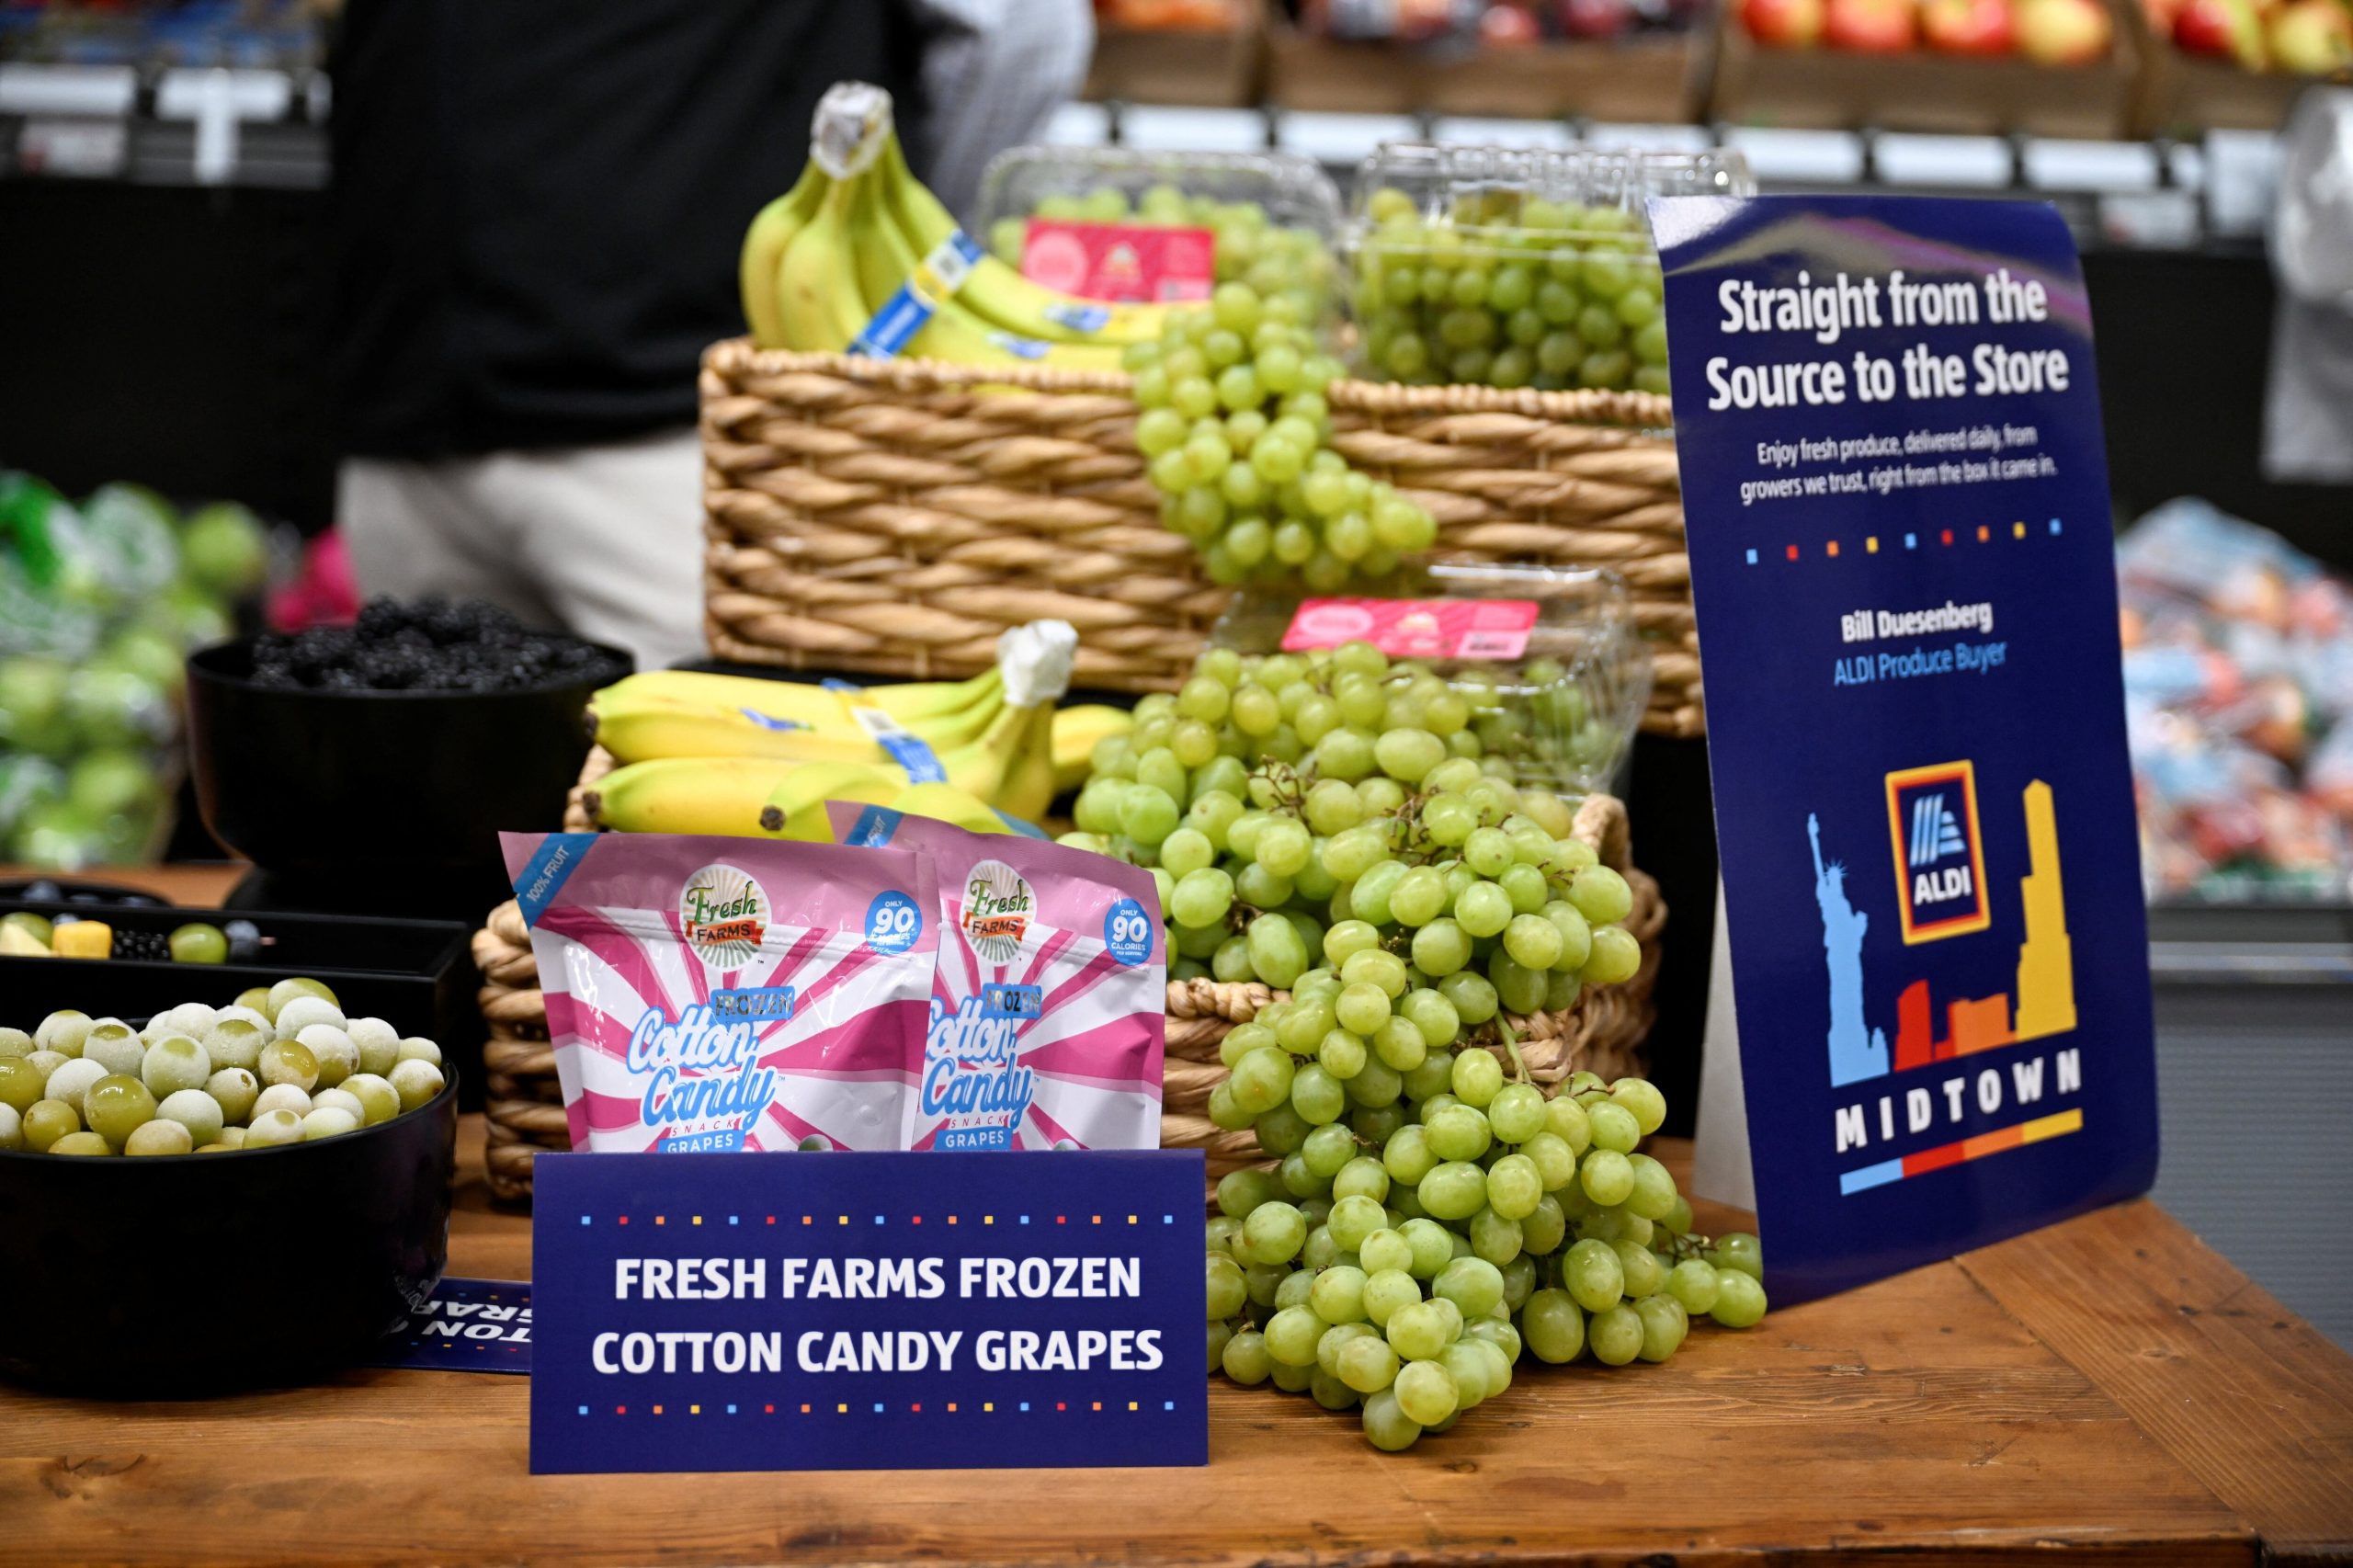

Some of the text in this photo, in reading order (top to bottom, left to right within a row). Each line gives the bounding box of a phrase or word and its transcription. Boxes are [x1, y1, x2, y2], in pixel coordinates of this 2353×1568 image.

[1718, 268, 2048, 344] Straight from the
[1706, 343, 2070, 411] Source to the Store
[1757, 439, 1799, 469] Enjoy
[1801, 436, 1838, 460] fresh
[1839, 433, 1904, 464] produce,
[1904, 426, 1967, 454] delivered
[2003, 423, 2038, 447] from
[1740, 477, 1802, 506] growers
[1803, 475, 1827, 494] we
[1828, 470, 1868, 494] trust,
[1869, 465, 1904, 495] right
[1904, 463, 1938, 487] from
[1938, 460, 1962, 484] the
[1962, 459, 1988, 483] box
[1989, 456, 2001, 480] it
[2001, 458, 2038, 480] came
[1841, 600, 1994, 642] Bill Duesenberg
[1835, 642, 2007, 687] ALDI Produce Buyer
[527, 845, 569, 902] 100% FRUIT
[1914, 866, 1972, 905] ALDI
[687, 881, 756, 925] Fresh
[971, 879, 1028, 916] Fresh
[697, 924, 750, 941] FARMS
[873, 906, 915, 934] 90
[972, 920, 1018, 934] FARMS
[1113, 915, 1147, 942] 90
[715, 992, 791, 1016] FROZEN
[986, 990, 1040, 1014] FROZEN
[628, 1004, 759, 1073] Cotton
[643, 1055, 776, 1131] Candy
[923, 1052, 1032, 1129] Candy
[1836, 1048, 2081, 1153] MIDTOWN
[667, 1133, 733, 1153] GRAPES
[672, 1119, 734, 1136] SNACK
[945, 1131, 1004, 1148] GRAPES
[951, 1116, 1004, 1129] SNACK
[615, 1256, 1140, 1300] FRESH FARMS FROZEN
[592, 1329, 1164, 1374] COTTON CANDY GRAPES
